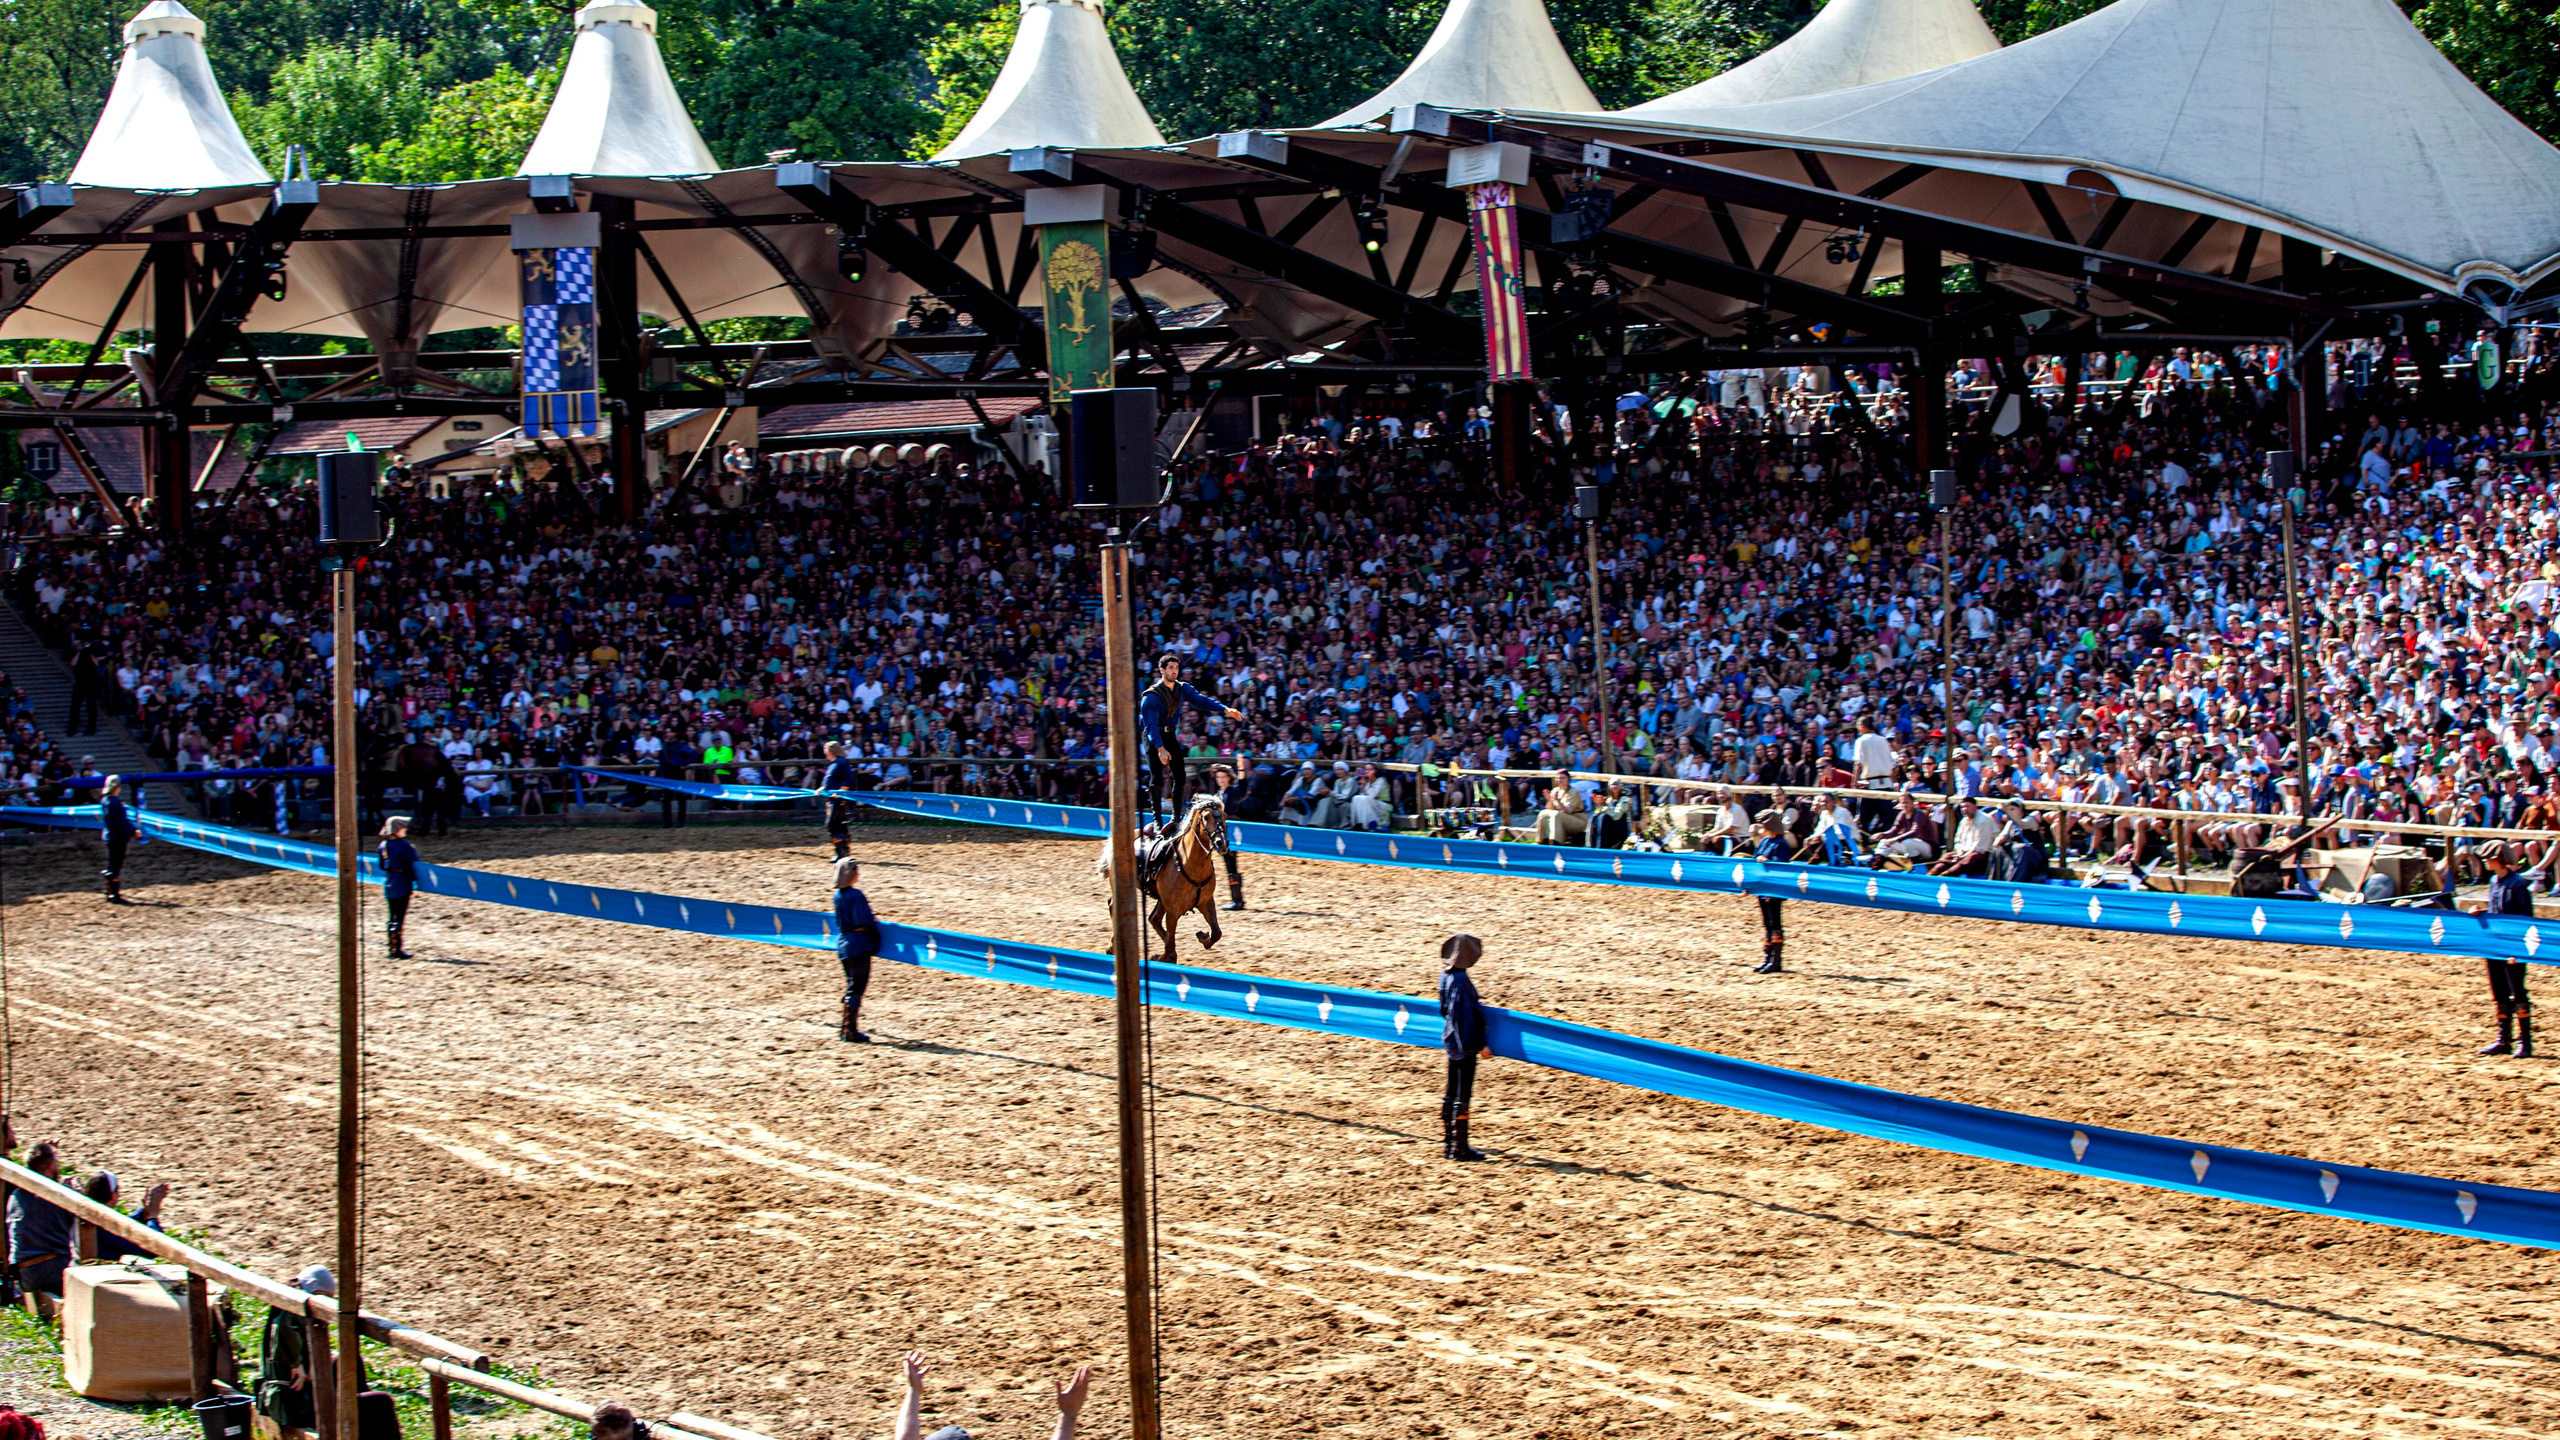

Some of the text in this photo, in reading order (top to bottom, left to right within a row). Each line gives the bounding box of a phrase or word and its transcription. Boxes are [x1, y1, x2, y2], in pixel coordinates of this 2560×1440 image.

[2353, 359, 2369, 387] H
[2480, 348, 2498, 380] G
[30, 446, 57, 472] H
